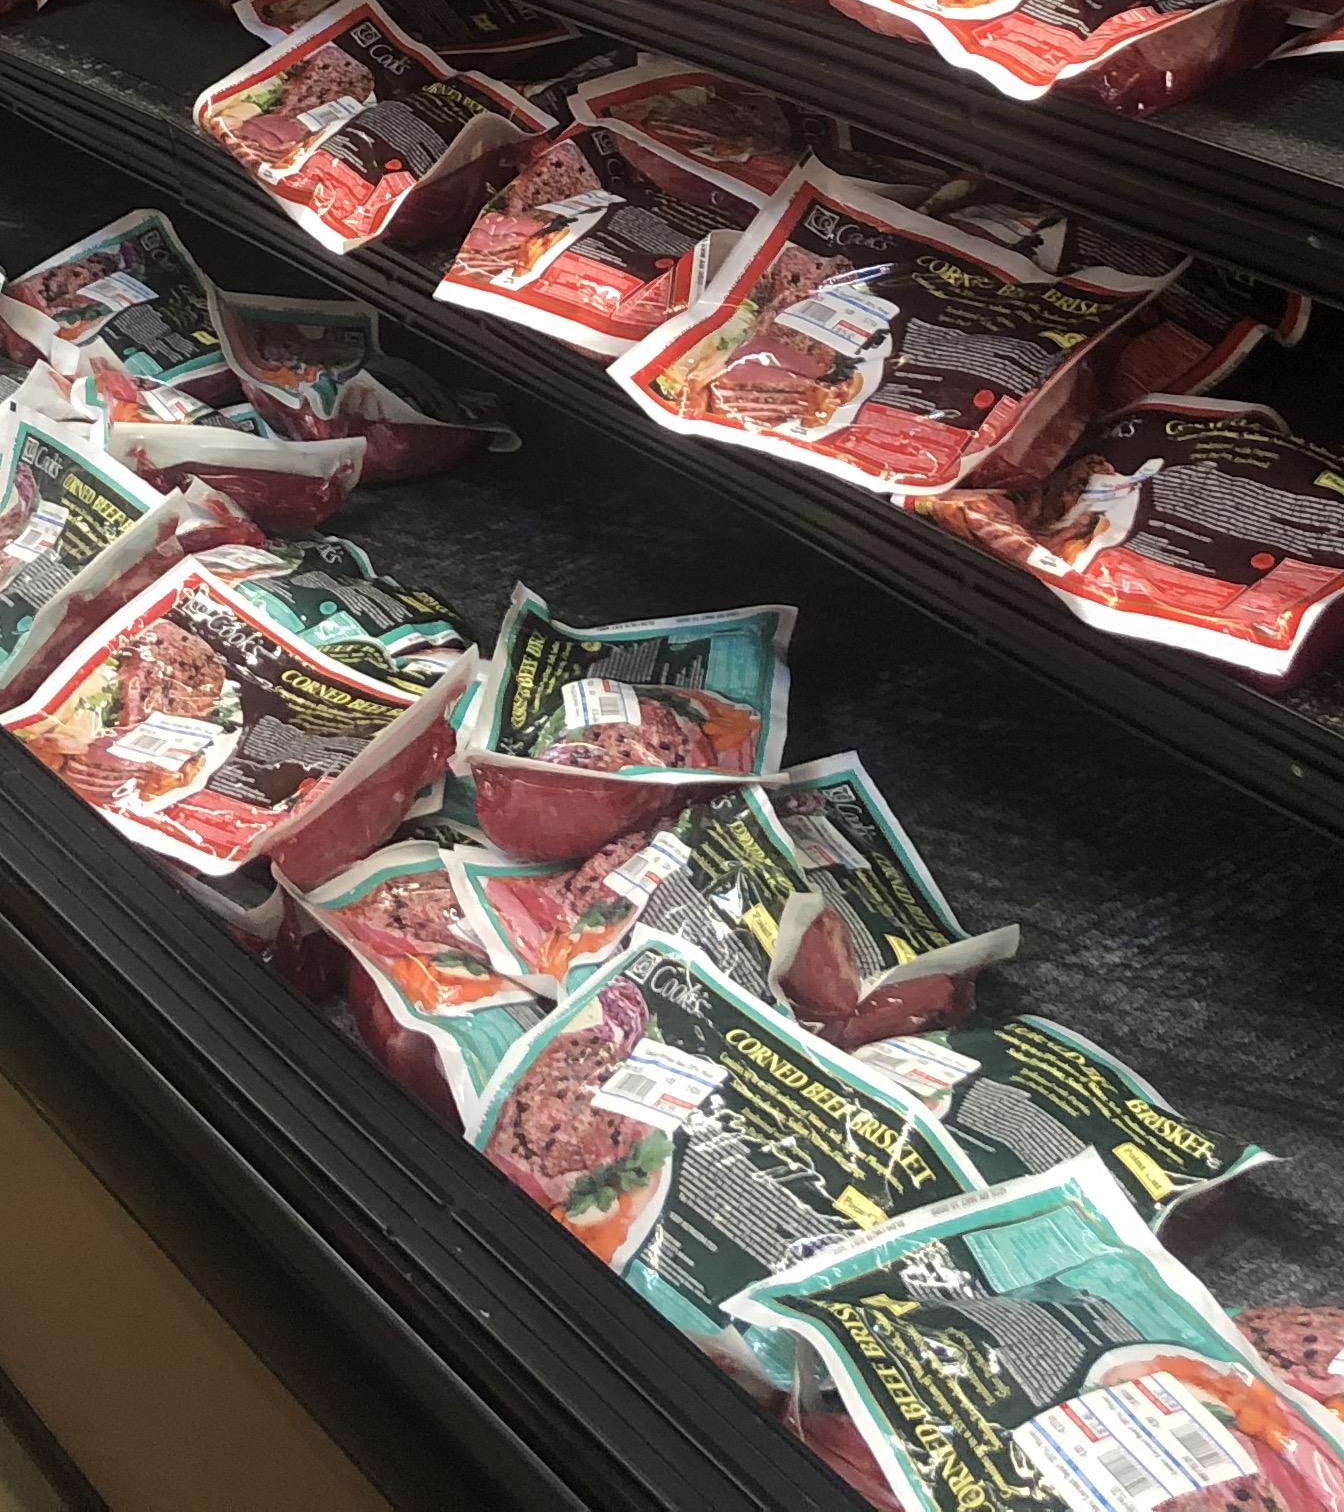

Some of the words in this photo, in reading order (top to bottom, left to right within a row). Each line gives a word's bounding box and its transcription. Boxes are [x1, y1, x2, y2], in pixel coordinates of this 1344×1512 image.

[369, 44, 413, 77] Cook's
[280, 669, 352, 705] CORNED
[725, 1028, 809, 1089] CORNED
[799, 1080, 856, 1121] BEEF
[849, 1106, 937, 1189] BRISKET
[1124, 1098, 1217, 1160] BRISKET
[872, 1363, 927, 1421] BEEF
